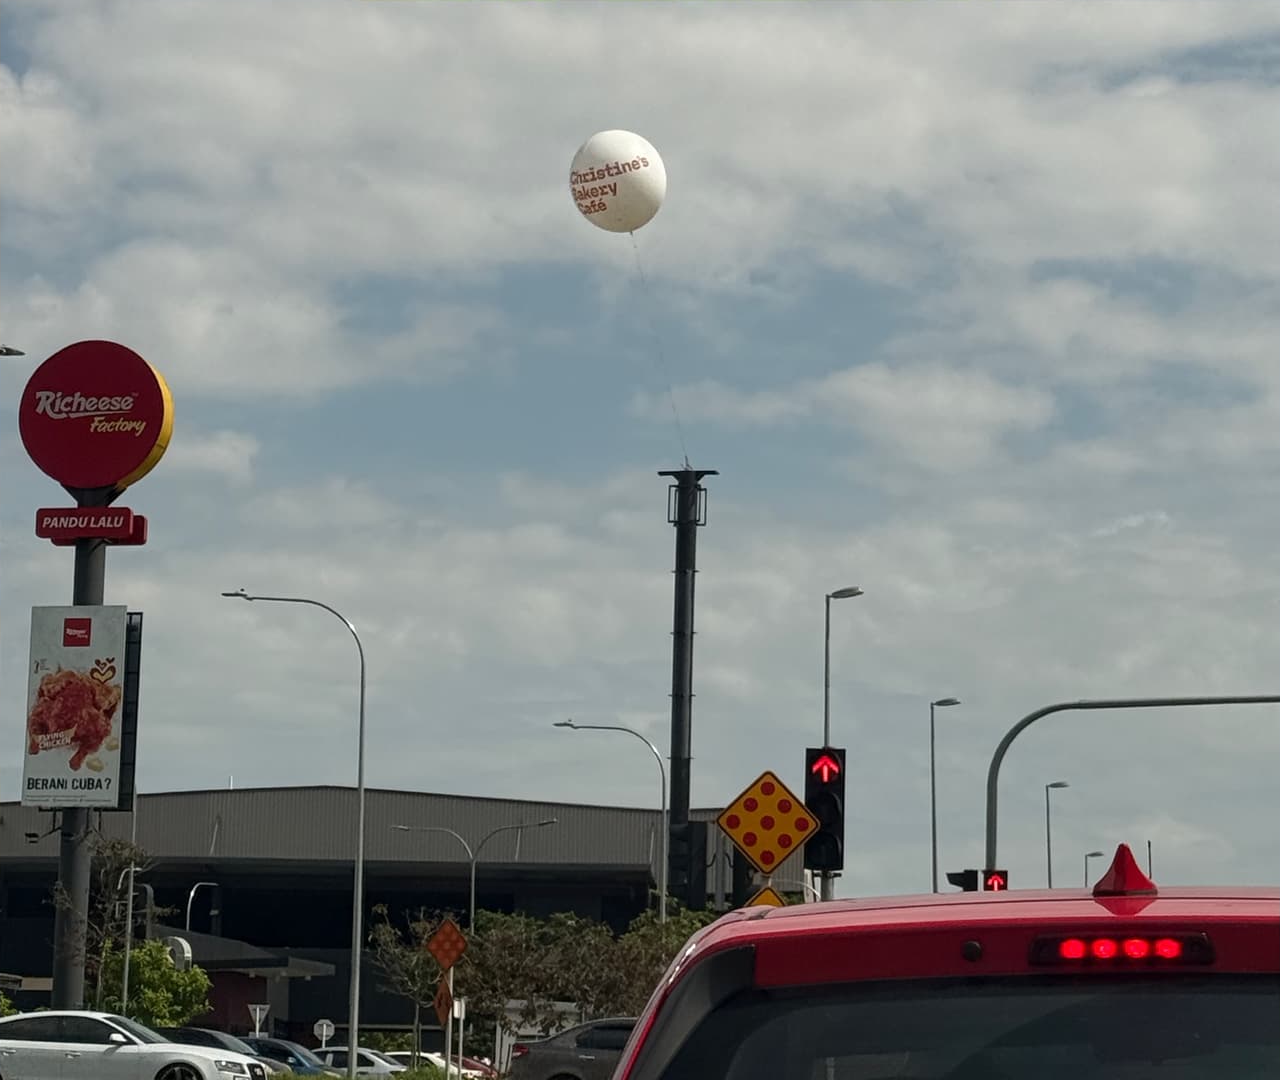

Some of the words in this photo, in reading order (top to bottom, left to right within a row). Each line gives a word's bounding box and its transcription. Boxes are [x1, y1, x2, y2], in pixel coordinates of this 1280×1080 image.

[570, 156, 649, 185] Christine's
[35, 391, 134, 419] Richeese
[90, 416, 146, 437] Factory
[42, 516, 88, 529] PANDU
[90, 516, 124, 528] LALU
[27, 778, 68, 790] BERANI
